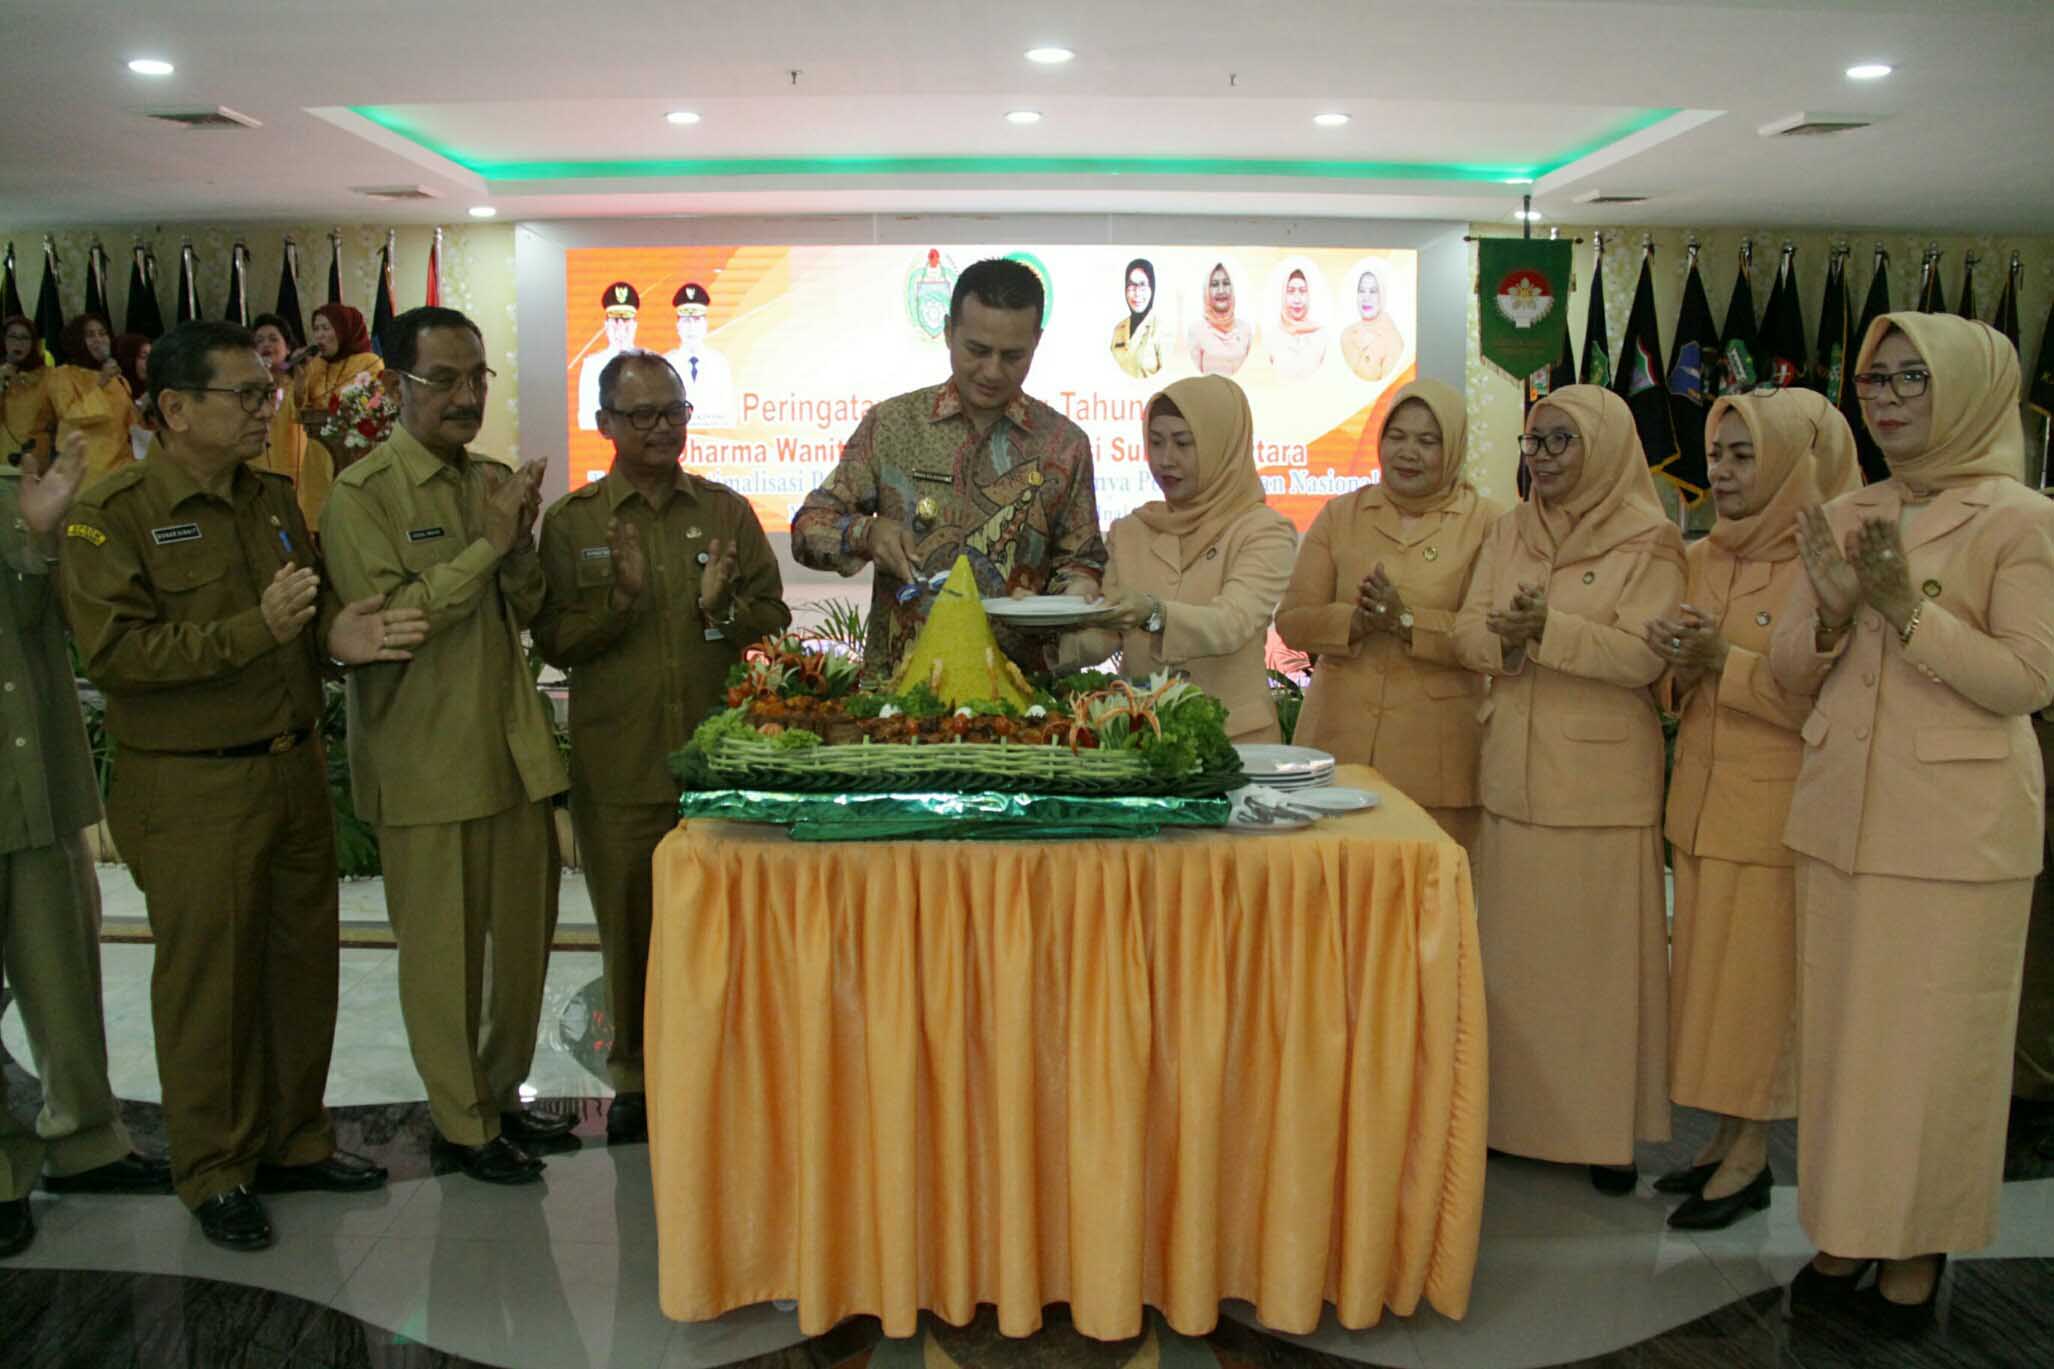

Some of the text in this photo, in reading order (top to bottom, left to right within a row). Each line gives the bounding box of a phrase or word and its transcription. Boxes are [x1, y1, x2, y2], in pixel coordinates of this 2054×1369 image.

[743, 391, 1146, 430] Peringata Tahun
[776, 437, 848, 463] Wanit
[1256, 440, 1305, 463] tara
